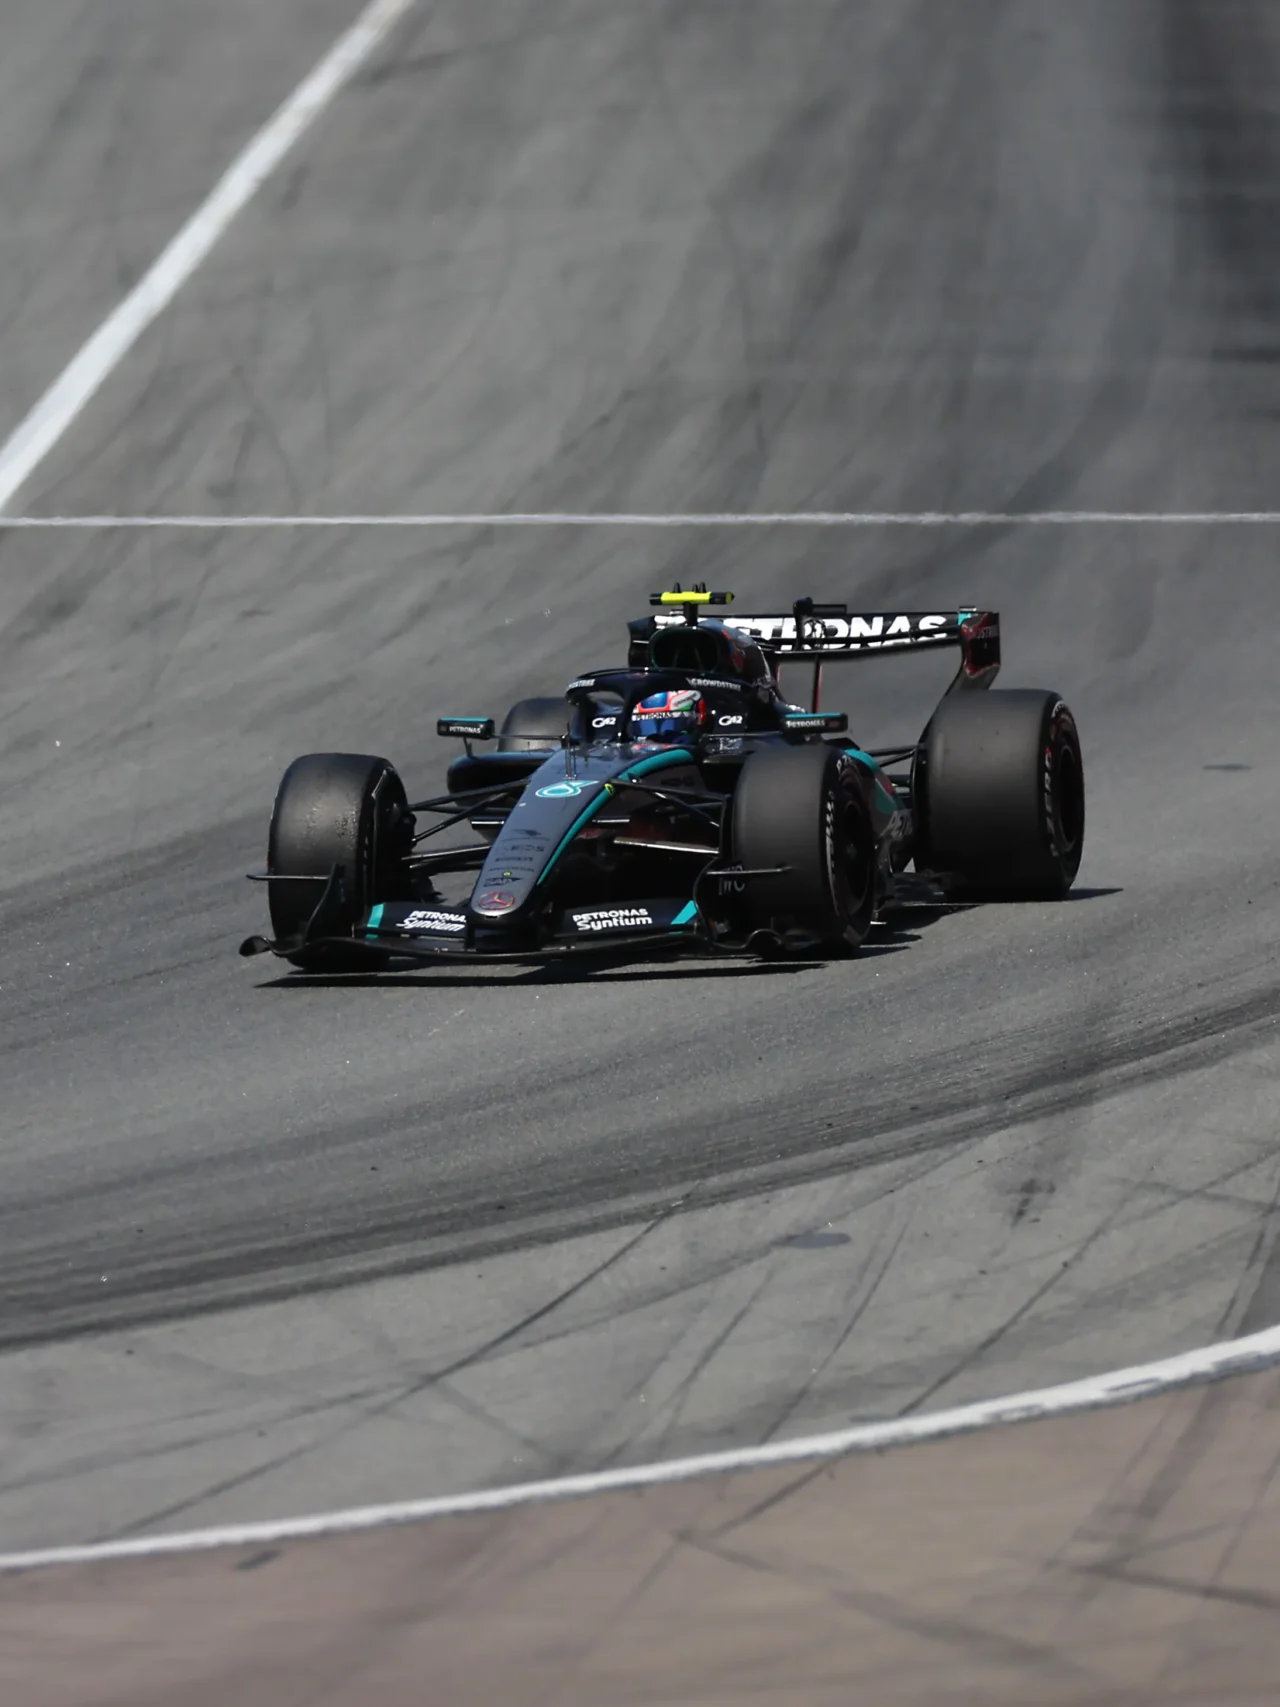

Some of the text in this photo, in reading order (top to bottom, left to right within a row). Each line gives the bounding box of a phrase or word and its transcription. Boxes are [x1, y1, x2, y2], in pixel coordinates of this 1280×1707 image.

[449, 725, 481, 734] PETRONAS
[409, 910, 467, 924] PETRONA
[573, 908, 648, 922] PETRONAS
[578, 914, 652, 931] Syntium
